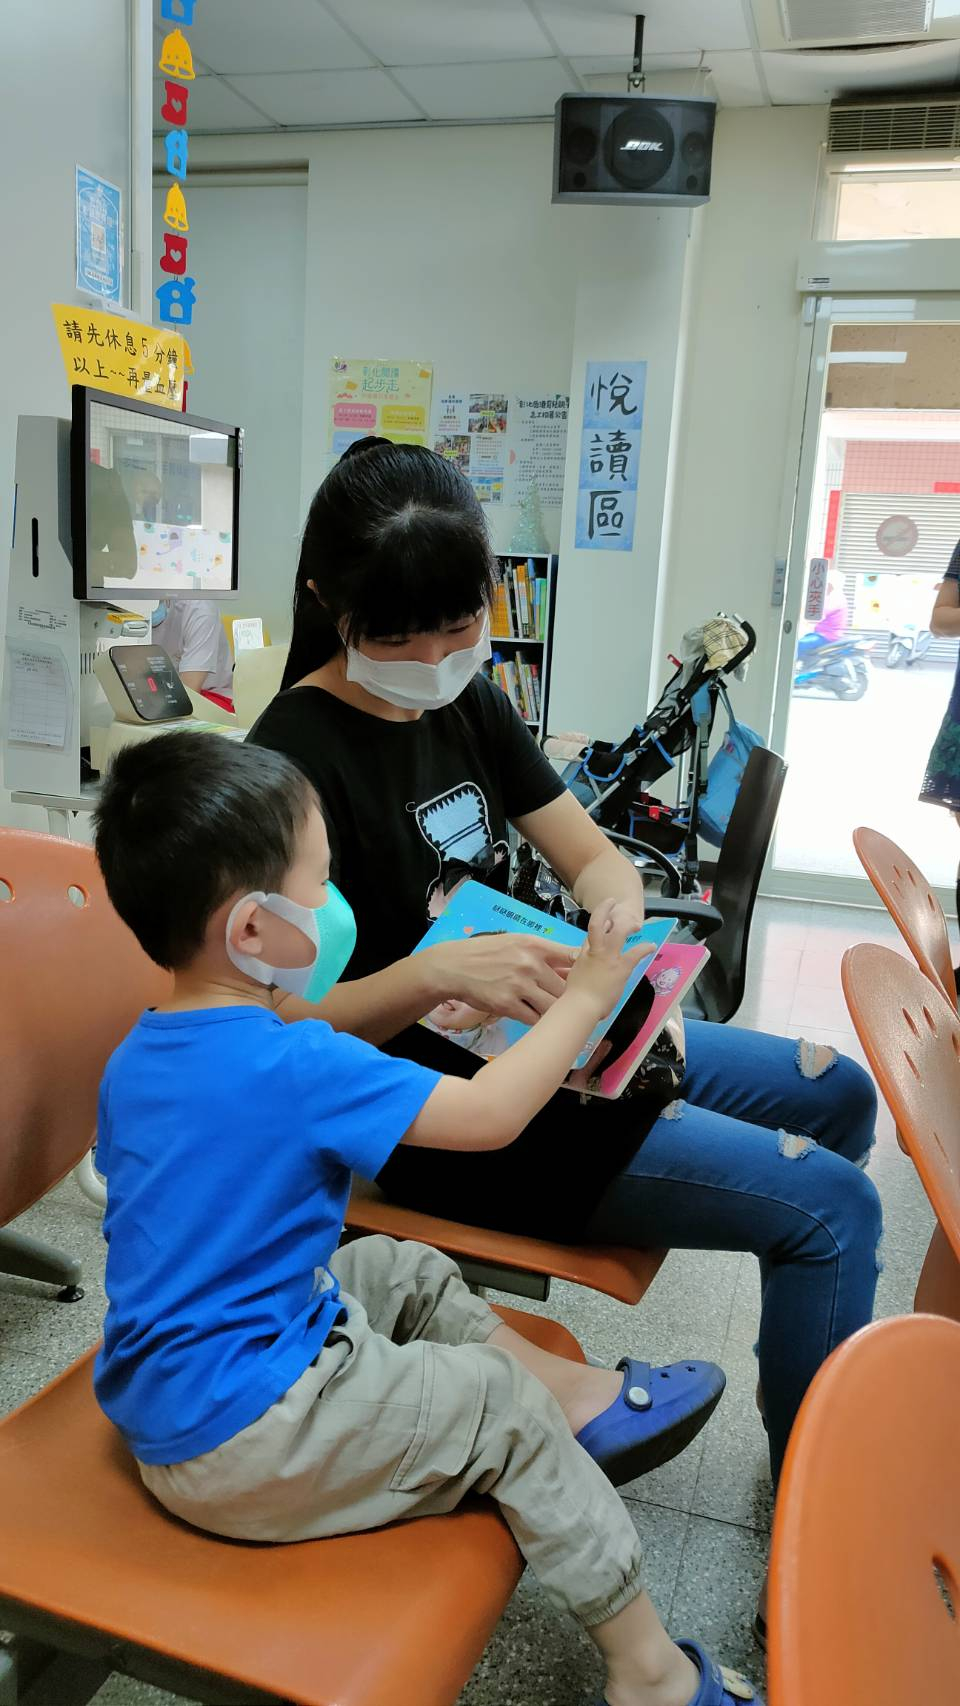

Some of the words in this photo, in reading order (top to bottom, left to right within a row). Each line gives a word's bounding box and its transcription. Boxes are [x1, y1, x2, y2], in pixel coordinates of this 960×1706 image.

[63, 320, 178, 369] 請先休息5分鐘
[362, 378, 400, 393] 起步走
[588, 372, 637, 540] 悅讀區
[807, 562, 826, 617] 小心夾手
